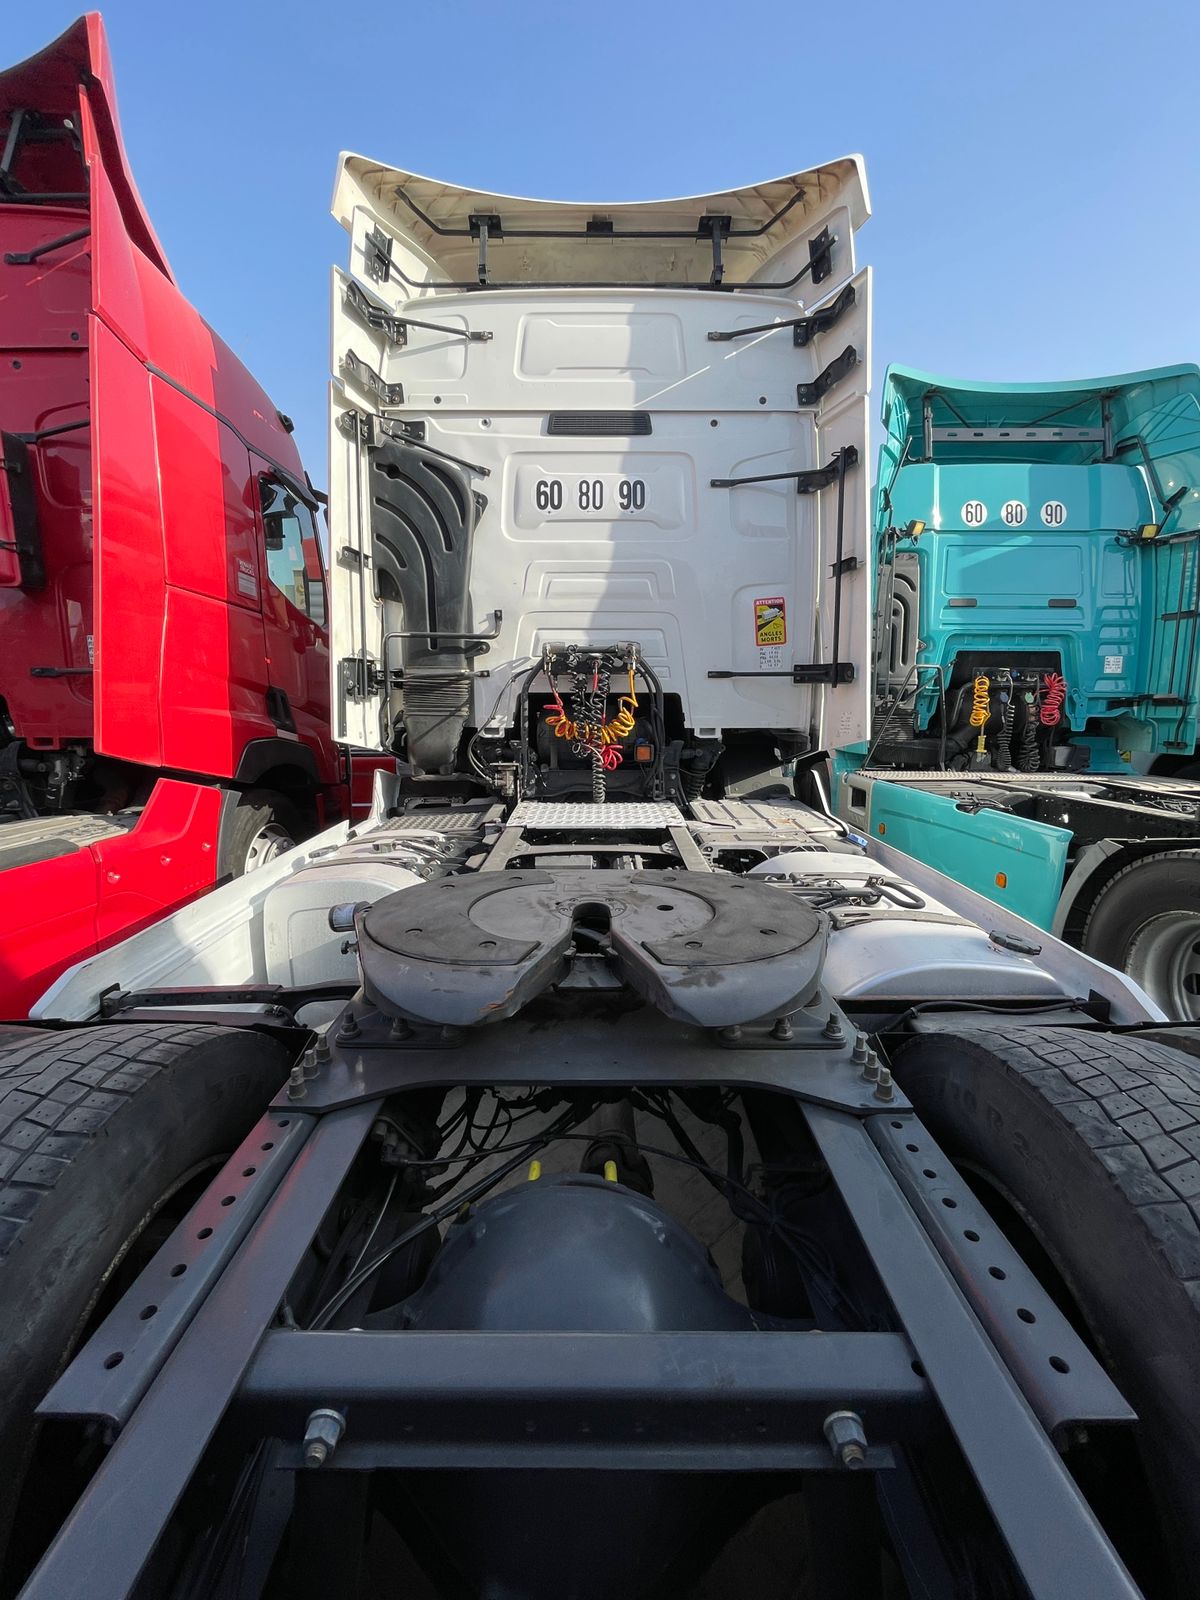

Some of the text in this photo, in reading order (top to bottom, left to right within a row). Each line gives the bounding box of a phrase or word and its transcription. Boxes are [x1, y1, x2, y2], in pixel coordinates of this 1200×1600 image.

[536, 480, 645, 510] 60 80 90
[966, 503, 1062, 524] 60 80 90
